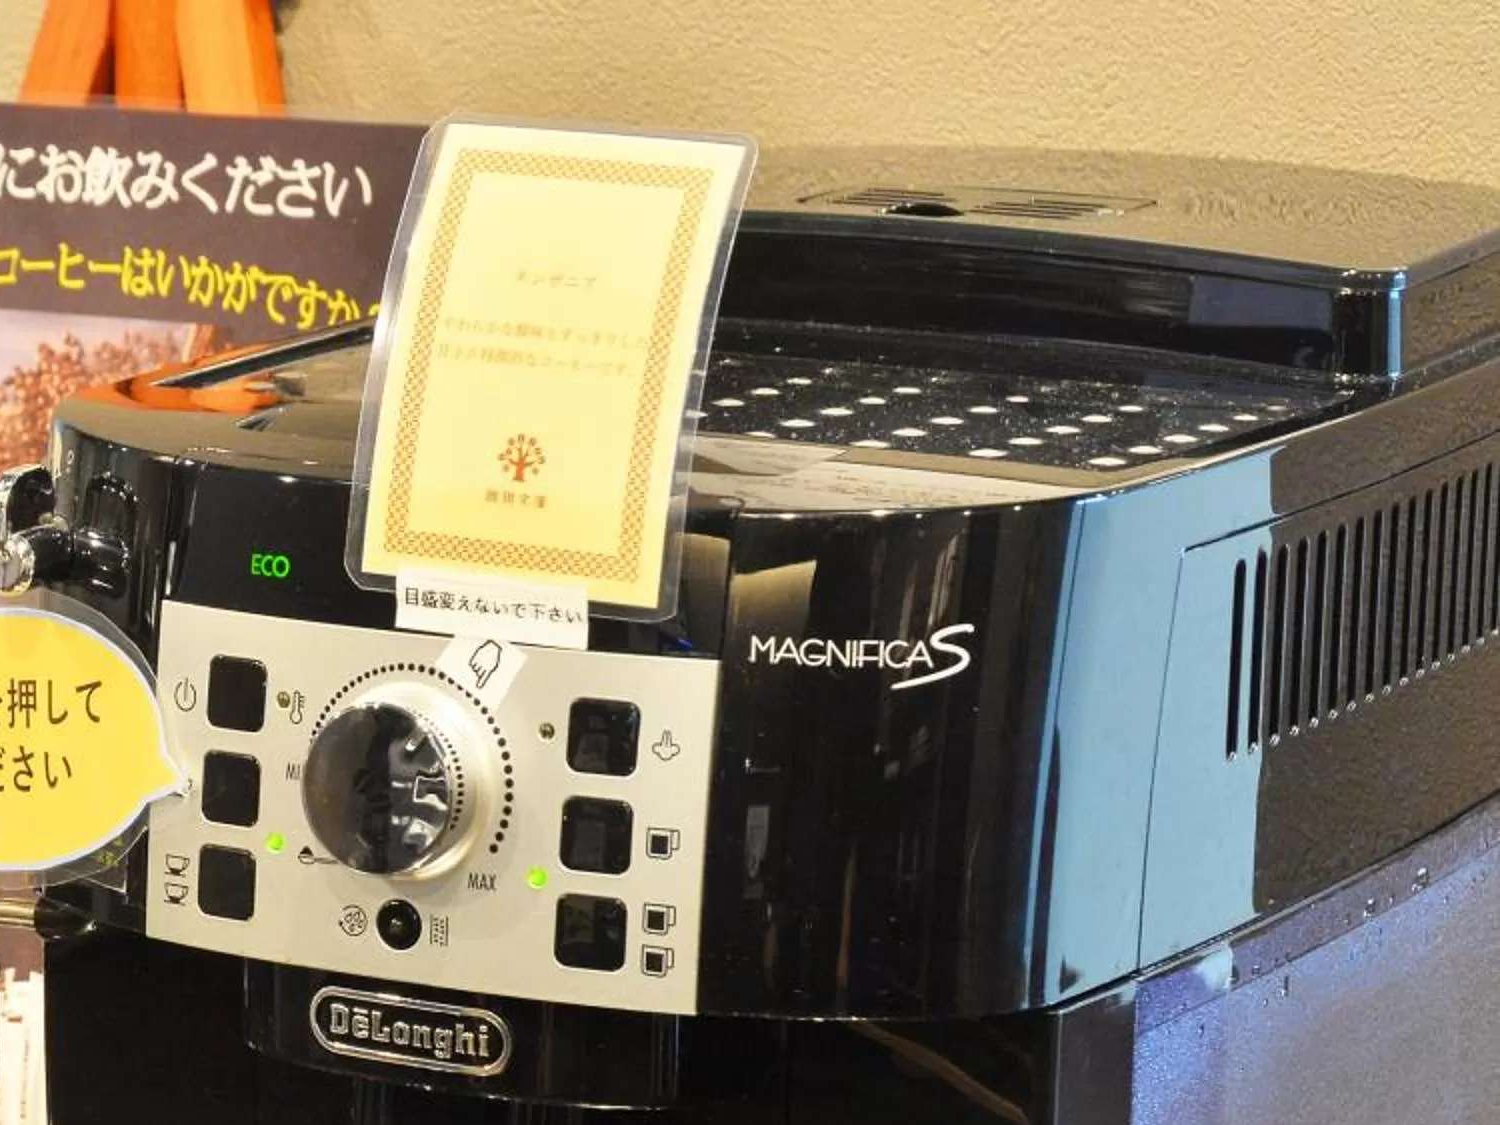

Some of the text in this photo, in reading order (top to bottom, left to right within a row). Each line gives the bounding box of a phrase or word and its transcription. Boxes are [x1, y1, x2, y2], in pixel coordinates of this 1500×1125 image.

[251, 553, 290, 577] ECO
[404, 586, 584, 625] 目盛変えないで下さい
[748, 634, 934, 670] MAGNIFICA
[285, 763, 302, 781] MI
[467, 871, 498, 890] MAX
